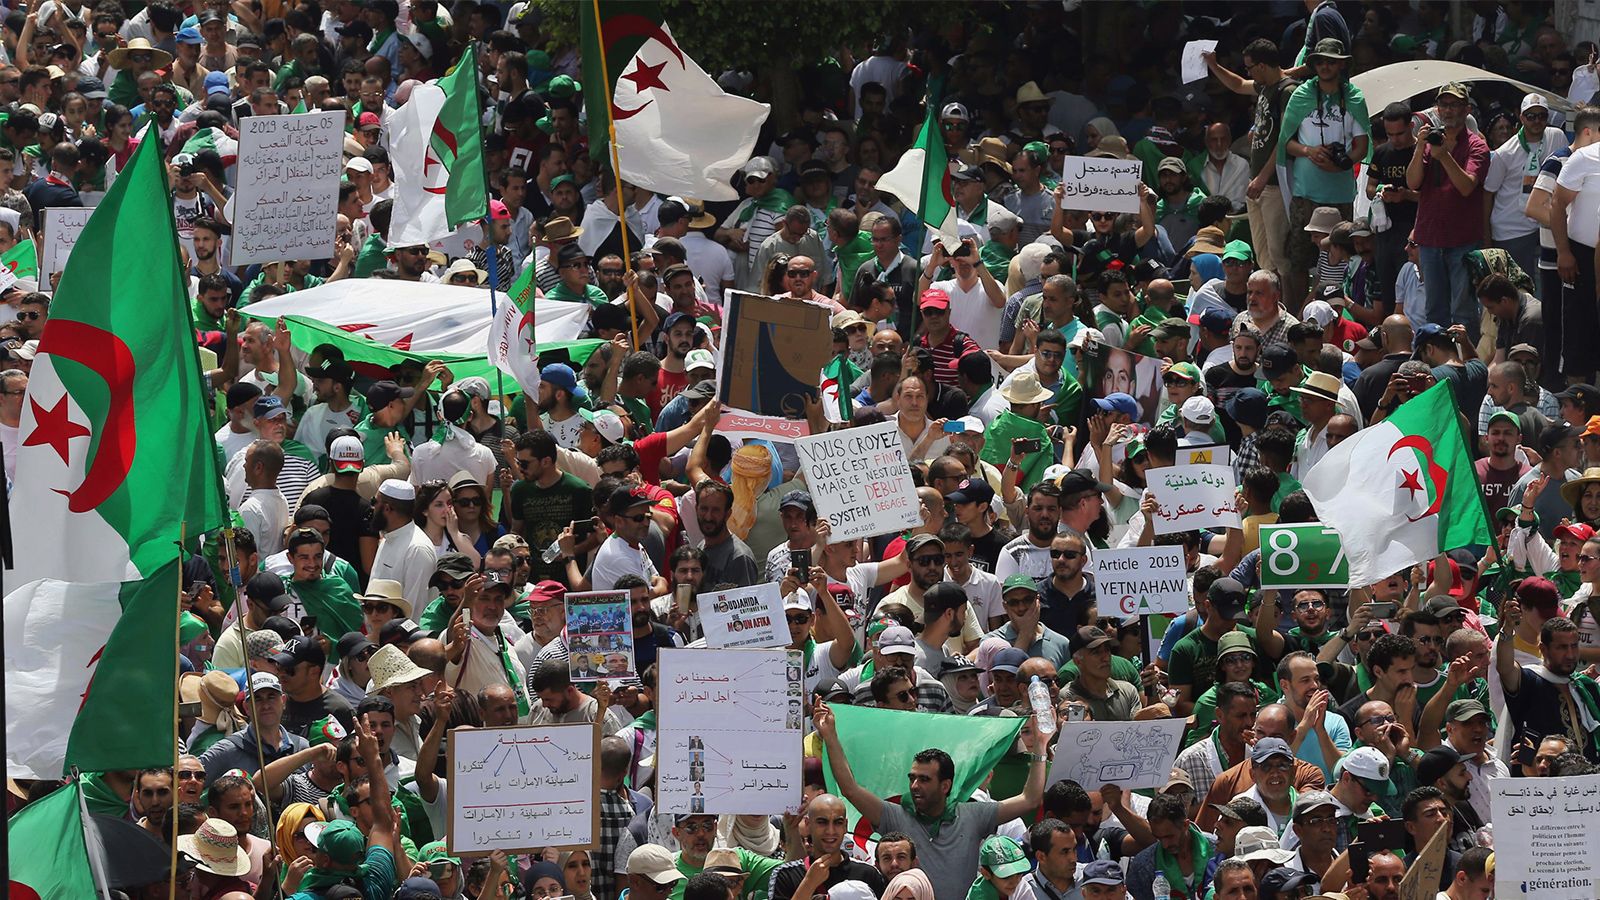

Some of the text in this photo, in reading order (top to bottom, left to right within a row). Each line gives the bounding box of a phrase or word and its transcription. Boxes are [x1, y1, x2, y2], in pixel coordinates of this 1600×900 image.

[249, 120, 277, 134] 2019
[320, 117, 334, 129] 05
[259, 135, 292, 152] الشعب
[1075, 161, 1109, 180] منجل
[800, 430, 901, 462] VOUS CROYEZ
[811, 462, 841, 480] QUE
[849, 474, 861, 486] CE
[1201, 470, 1225, 489] دولة
[839, 477, 904, 504] LE DEBUT
[829, 497, 909, 527] SYSTEM DEGAGE
[1268, 529, 1300, 576] 8
[1321, 529, 1346, 575] 7
[1099, 555, 1179, 571] Article 2019
[675, 672, 731, 684] ضحينا من
[674, 689, 731, 704] أجل الجزائر
[498, 733, 551, 748] عصابة
[567, 751, 592, 762] عملاء
[741, 759, 788, 772] ضحينا
[545, 773, 580, 786] الصهاينة
[740, 779, 790, 791] بالجزائر
[480, 781, 502, 793] باعوا
[1547, 787, 1558, 800] في
[1563, 785, 1580, 798] غاية
[519, 807, 552, 819] الصهاينة
[559, 806, 585, 816] عملاء
[1507, 805, 1526, 817] الحق
[472, 829, 521, 845] تنكروا
[541, 826, 574, 840] باعوا
[1529, 876, 1592, 892] génération.
